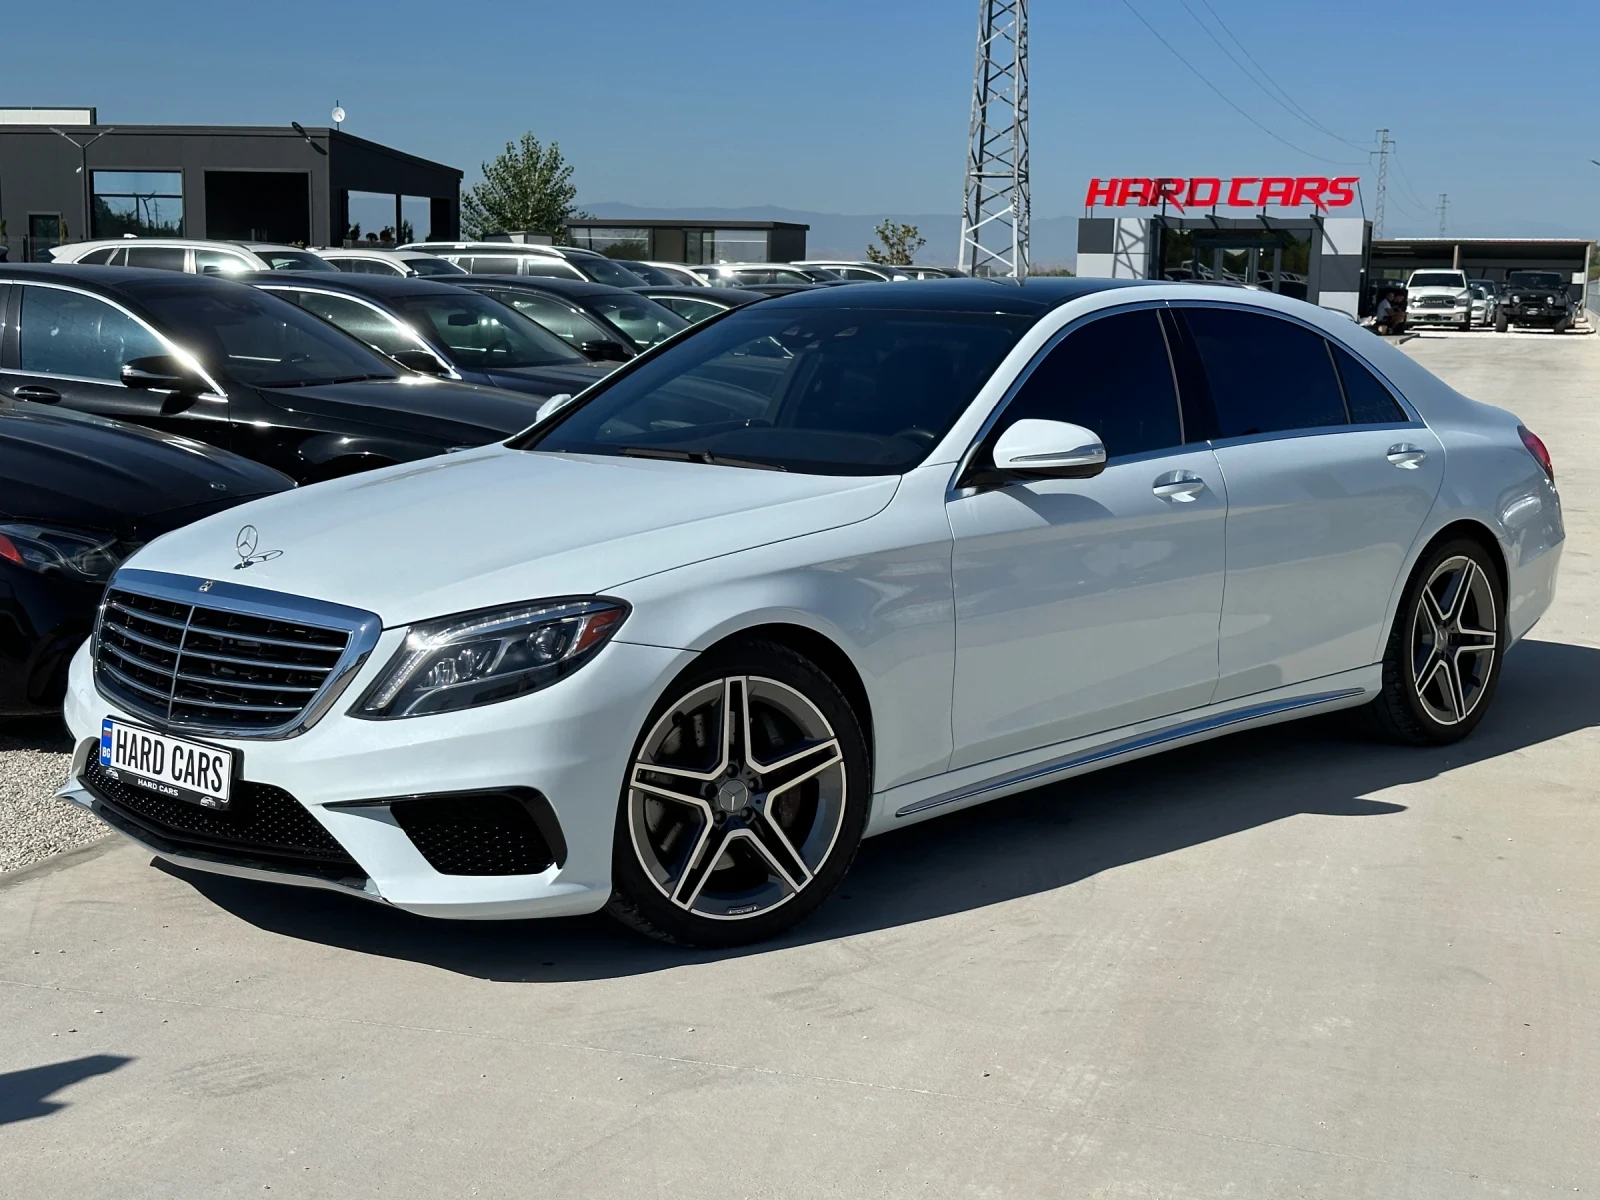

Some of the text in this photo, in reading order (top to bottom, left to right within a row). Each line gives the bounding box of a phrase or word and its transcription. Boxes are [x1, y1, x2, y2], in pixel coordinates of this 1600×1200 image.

[1085, 177, 1360, 215] HARD CARS
[102, 747, 111, 758] BG
[116, 729, 223, 793] HARD CARS
[138, 779, 179, 796] HARD CARS
